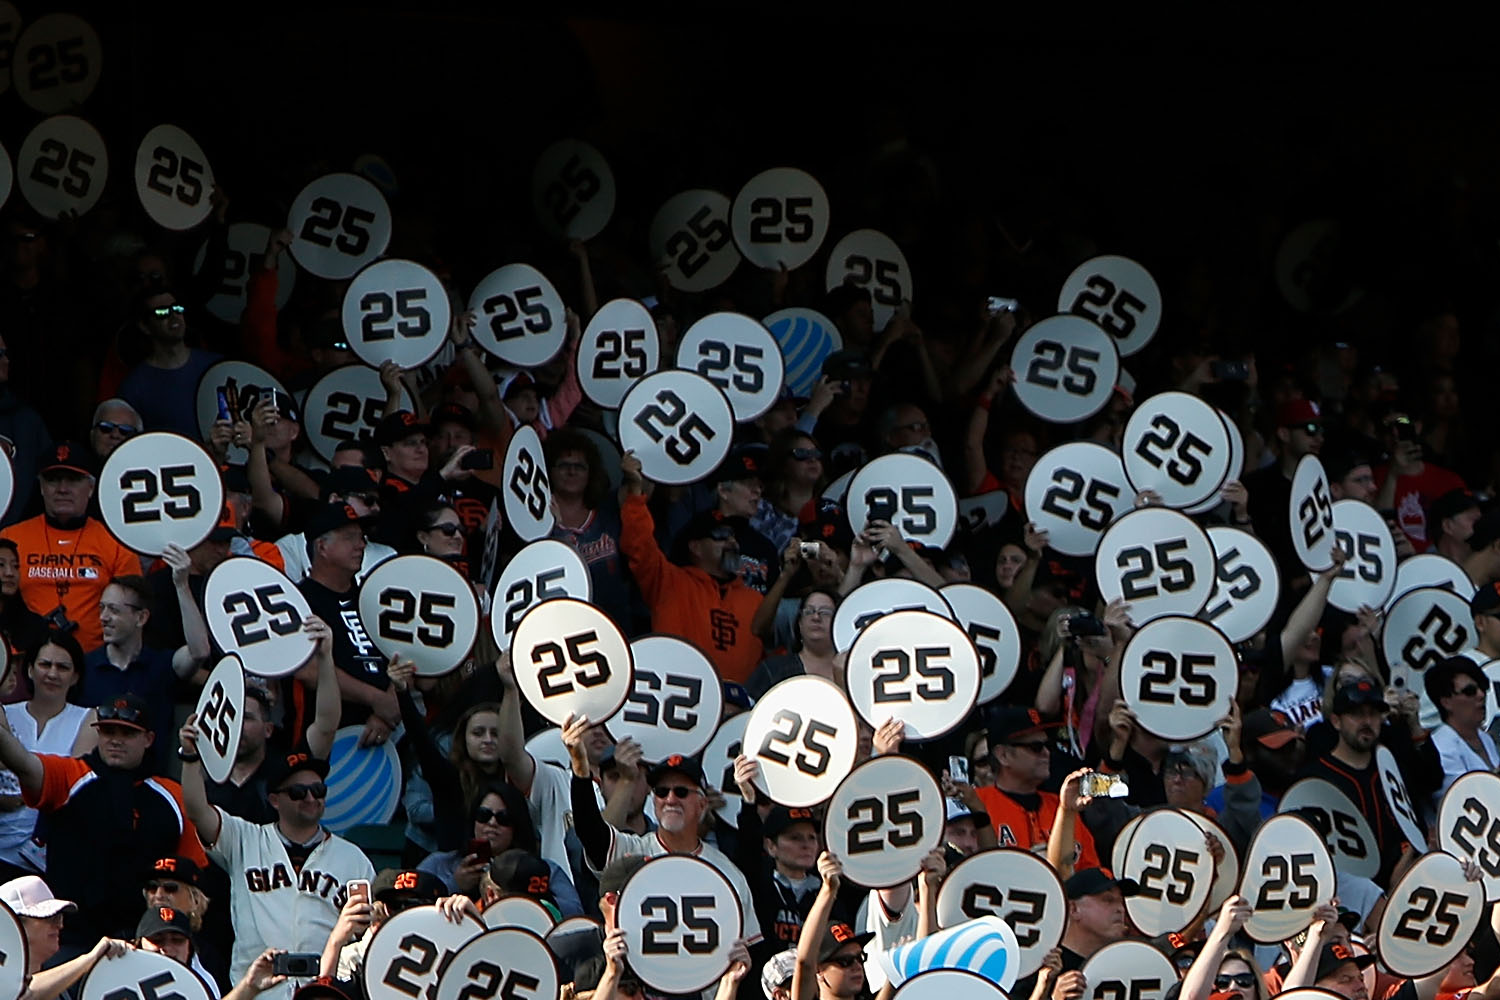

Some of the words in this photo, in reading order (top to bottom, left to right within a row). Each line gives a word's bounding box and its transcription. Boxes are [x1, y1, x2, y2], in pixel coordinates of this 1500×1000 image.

[27, 38, 88, 91] 25
[31, 139, 94, 197] 25
[147, 146, 202, 206] 25
[301, 196, 374, 256] 25
[666, 207, 729, 278] 25
[750, 198, 814, 243] 25
[361, 288, 430, 342] 25
[484, 286, 552, 340] 25
[1071, 275, 1146, 339] 25
[593, 331, 646, 379] 25
[696, 340, 763, 393] 25
[1026, 340, 1099, 395] 25
[634, 390, 715, 466] 25
[1136, 414, 1211, 485] 25
[119, 465, 202, 524] 25
[510, 447, 548, 521] 25
[1042, 466, 1120, 531] 25
[1299, 478, 1334, 549] 25
[26, 552, 103, 568] GIANTS
[28, 566, 75, 580] BASEBALL
[1117, 538, 1194, 599] 25
[223, 584, 302, 647] 25
[378, 588, 456, 648] 25
[531, 631, 613, 699] 25
[871, 646, 956, 703] 25
[1139, 650, 1215, 706] 25
[200, 680, 235, 758] 25
[757, 707, 838, 777] 25
[847, 791, 924, 854] 25
[154, 857, 177, 873] 25
[245, 867, 347, 909] GIANTS
[394, 871, 419, 890] 25
[1140, 843, 1203, 905] 25
[1259, 854, 1318, 910] 25
[641, 896, 719, 954] 25
[831, 923, 856, 943] 25
[1393, 887, 1468, 944] 25
